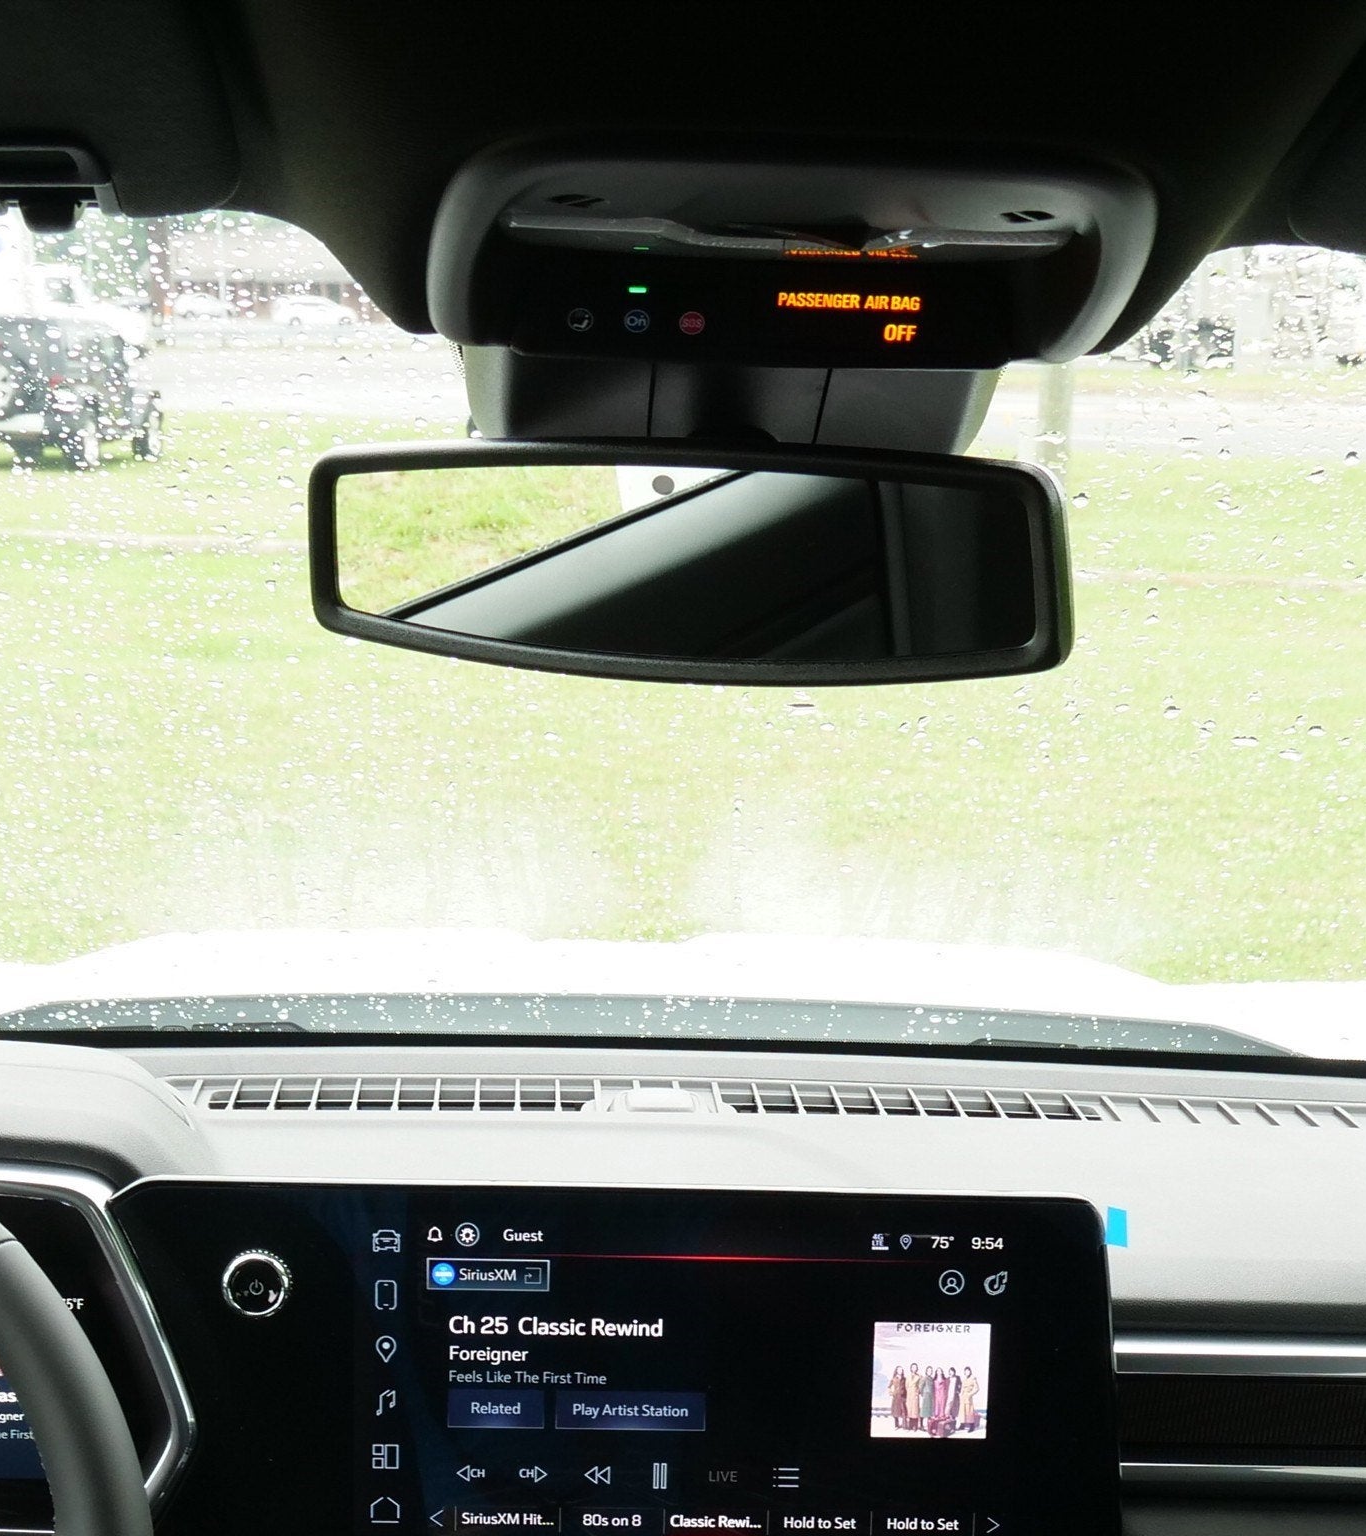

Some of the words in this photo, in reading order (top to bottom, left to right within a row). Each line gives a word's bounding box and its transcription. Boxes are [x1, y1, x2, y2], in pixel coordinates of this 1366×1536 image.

[778, 292, 860, 309] PASSENGER
[864, 295, 889, 310] AIR
[890, 296, 921, 311] BAG
[682, 319, 702, 328] SOS
[884, 324, 917, 341] OFF
[503, 1229, 544, 1242] Guest
[931, 1236, 954, 1249] 75°
[971, 1237, 1004, 1249] 9:54
[459, 1268, 517, 1281] SiriusXM
[448, 1315, 476, 1335] Ch
[480, 1317, 509, 1335] 25
[517, 1317, 586, 1336] Classic
[591, 1318, 663, 1337] Rewind
[896, 1323, 971, 1334] FOREIGNER
[448, 1346, 529, 1365] Foreigner
[448, 1370, 483, 1383] Feels
[486, 1371, 511, 1383] Like
[514, 1372, 539, 1384] The
[543, 1372, 572, 1384] First
[574, 1373, 607, 1385] Time
[471, 1402, 521, 1415] Related
[572, 1404, 599, 1418] Play
[602, 1404, 639, 1416] Artist
[642, 1405, 688, 1417] Station
[10, 1430, 35, 1440] First
[470, 1468, 485, 1478] CH
[519, 1468, 534, 1478] CH
[708, 1470, 738, 1482] LIVE
[462, 1512, 520, 1525] SiriusXM
[523, 1513, 554, 1526] Hit...
[582, 1514, 609, 1526] 80s
[612, 1517, 628, 1526] on
[631, 1515, 642, 1526] 8
[670, 1516, 715, 1528] Classic
[718, 1516, 762, 1528] Rewi...
[784, 1516, 815, 1529] Hold
[818, 1518, 831, 1529] to
[834, 1517, 856, 1530] Set
[887, 1518, 918, 1530] Hold
[920, 1519, 934, 1530] to
[937, 1519, 959, 1531] Set
